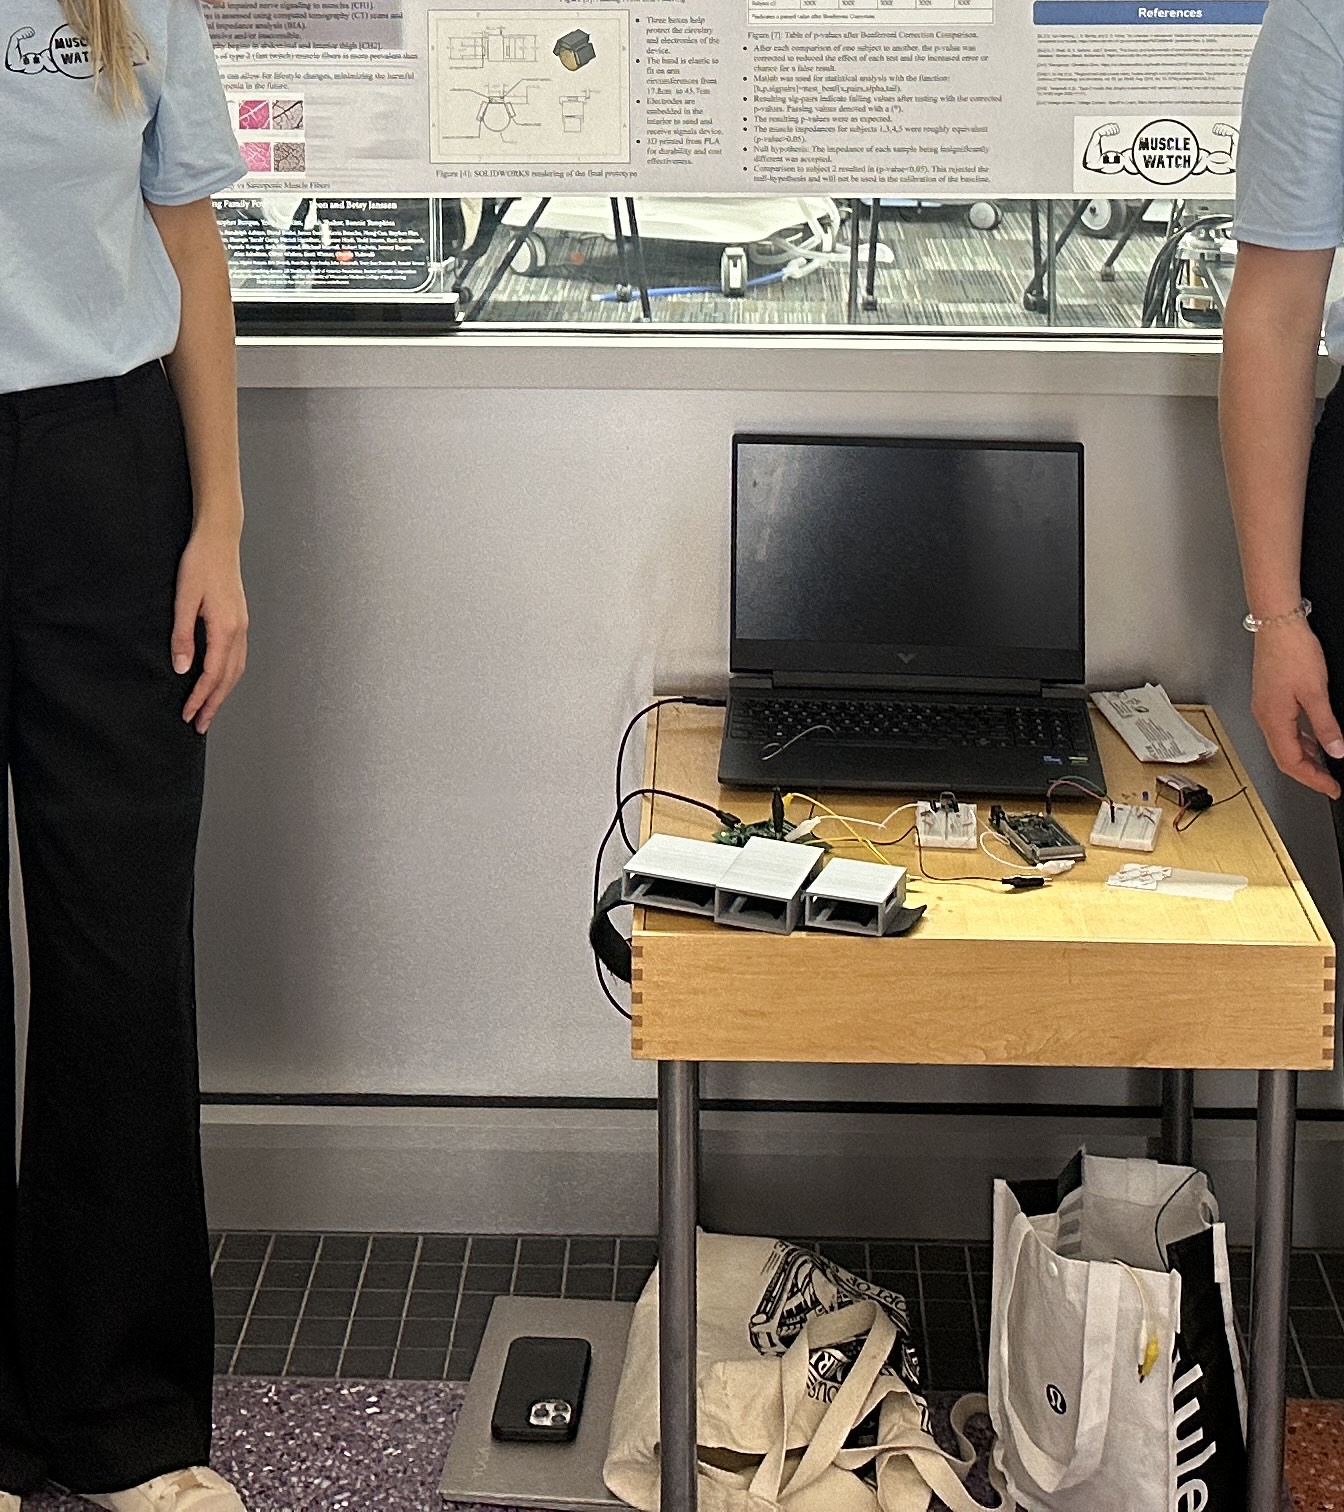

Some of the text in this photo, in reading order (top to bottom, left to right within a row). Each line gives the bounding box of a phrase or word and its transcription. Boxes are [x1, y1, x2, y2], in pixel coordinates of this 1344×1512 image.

[1138, 7, 1202, 17] References
[54, 36, 89, 50] MUSC
[60, 50, 90, 65] WAT
[1138, 136, 1191, 151] MUSCLE
[1143, 154, 1191, 169] WATCH
